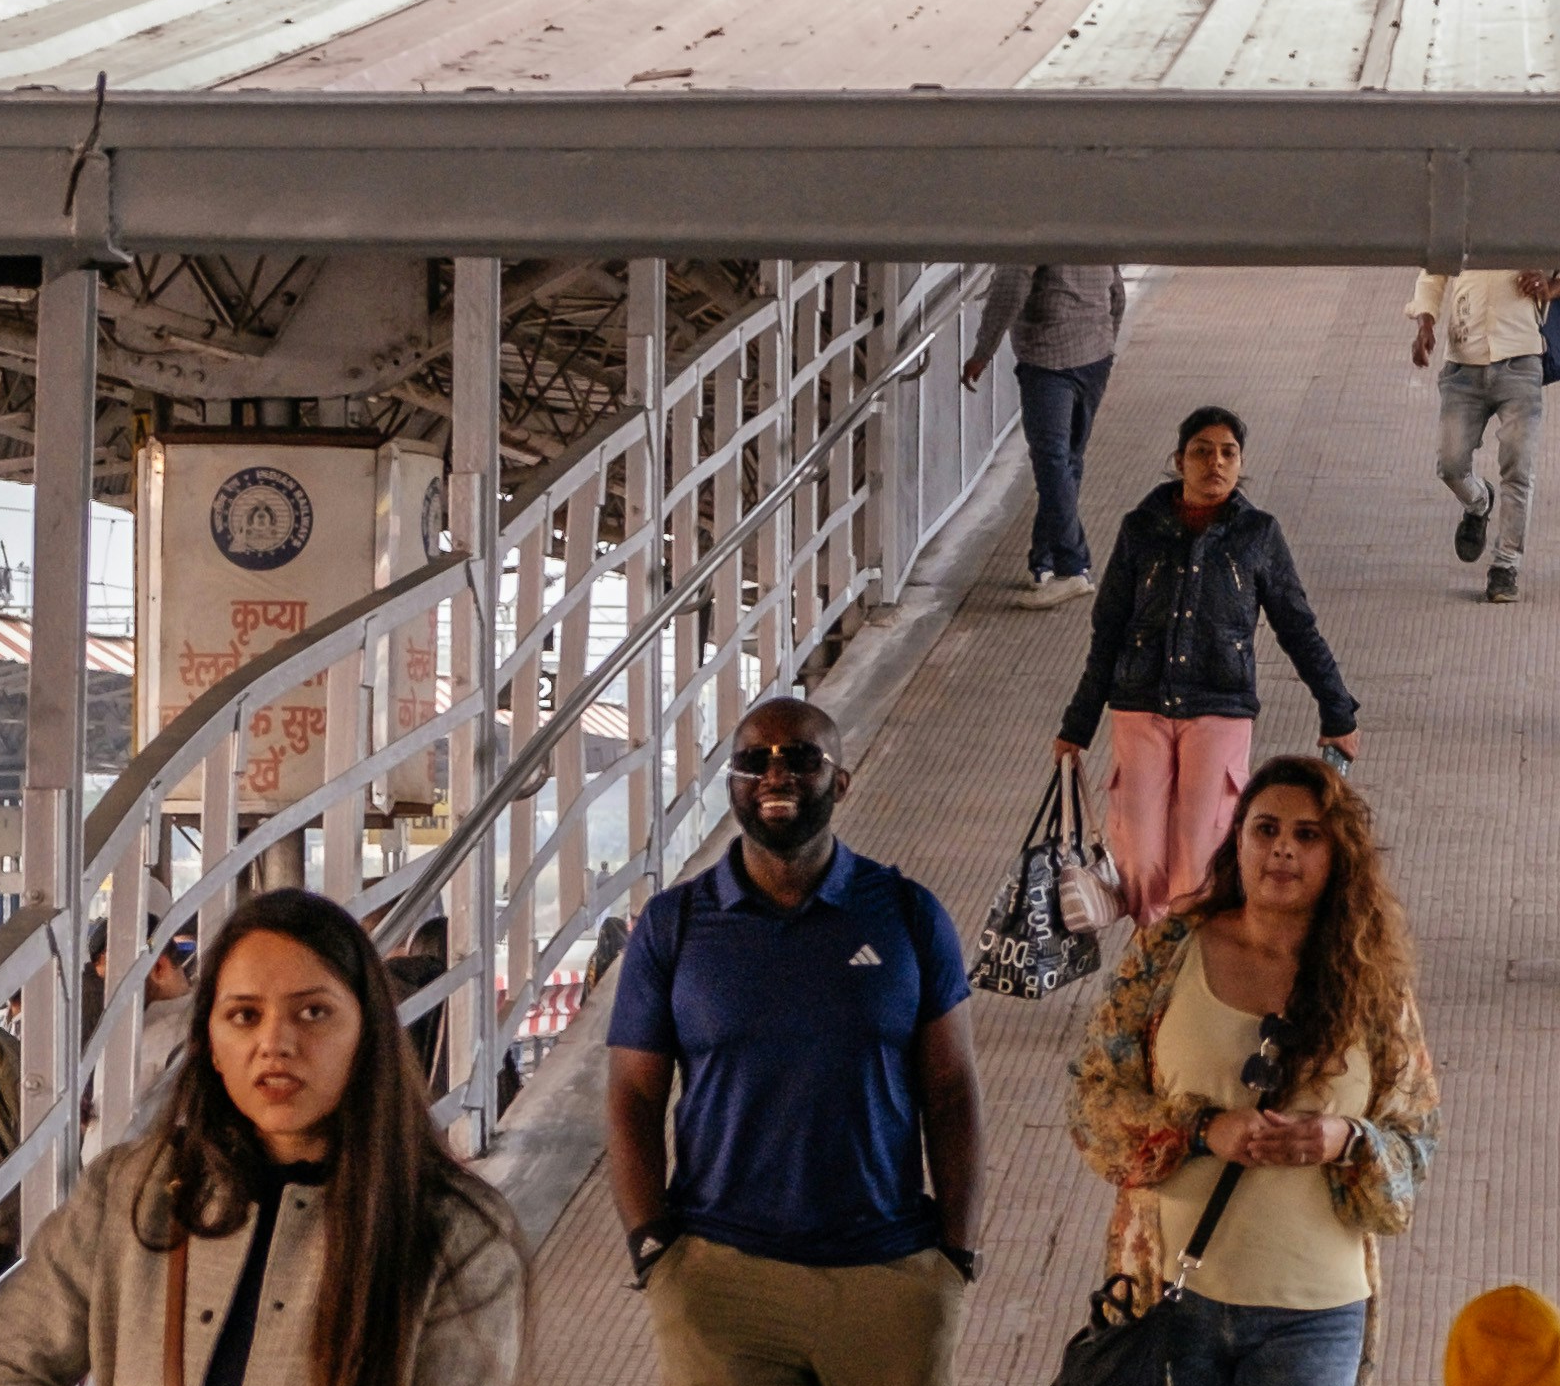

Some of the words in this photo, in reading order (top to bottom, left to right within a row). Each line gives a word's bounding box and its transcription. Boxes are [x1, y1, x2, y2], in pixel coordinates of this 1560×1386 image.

[231, 600, 307, 646] कृप्या
[282, 705, 327, 755] सुथ
[243, 745, 286, 794] खें
